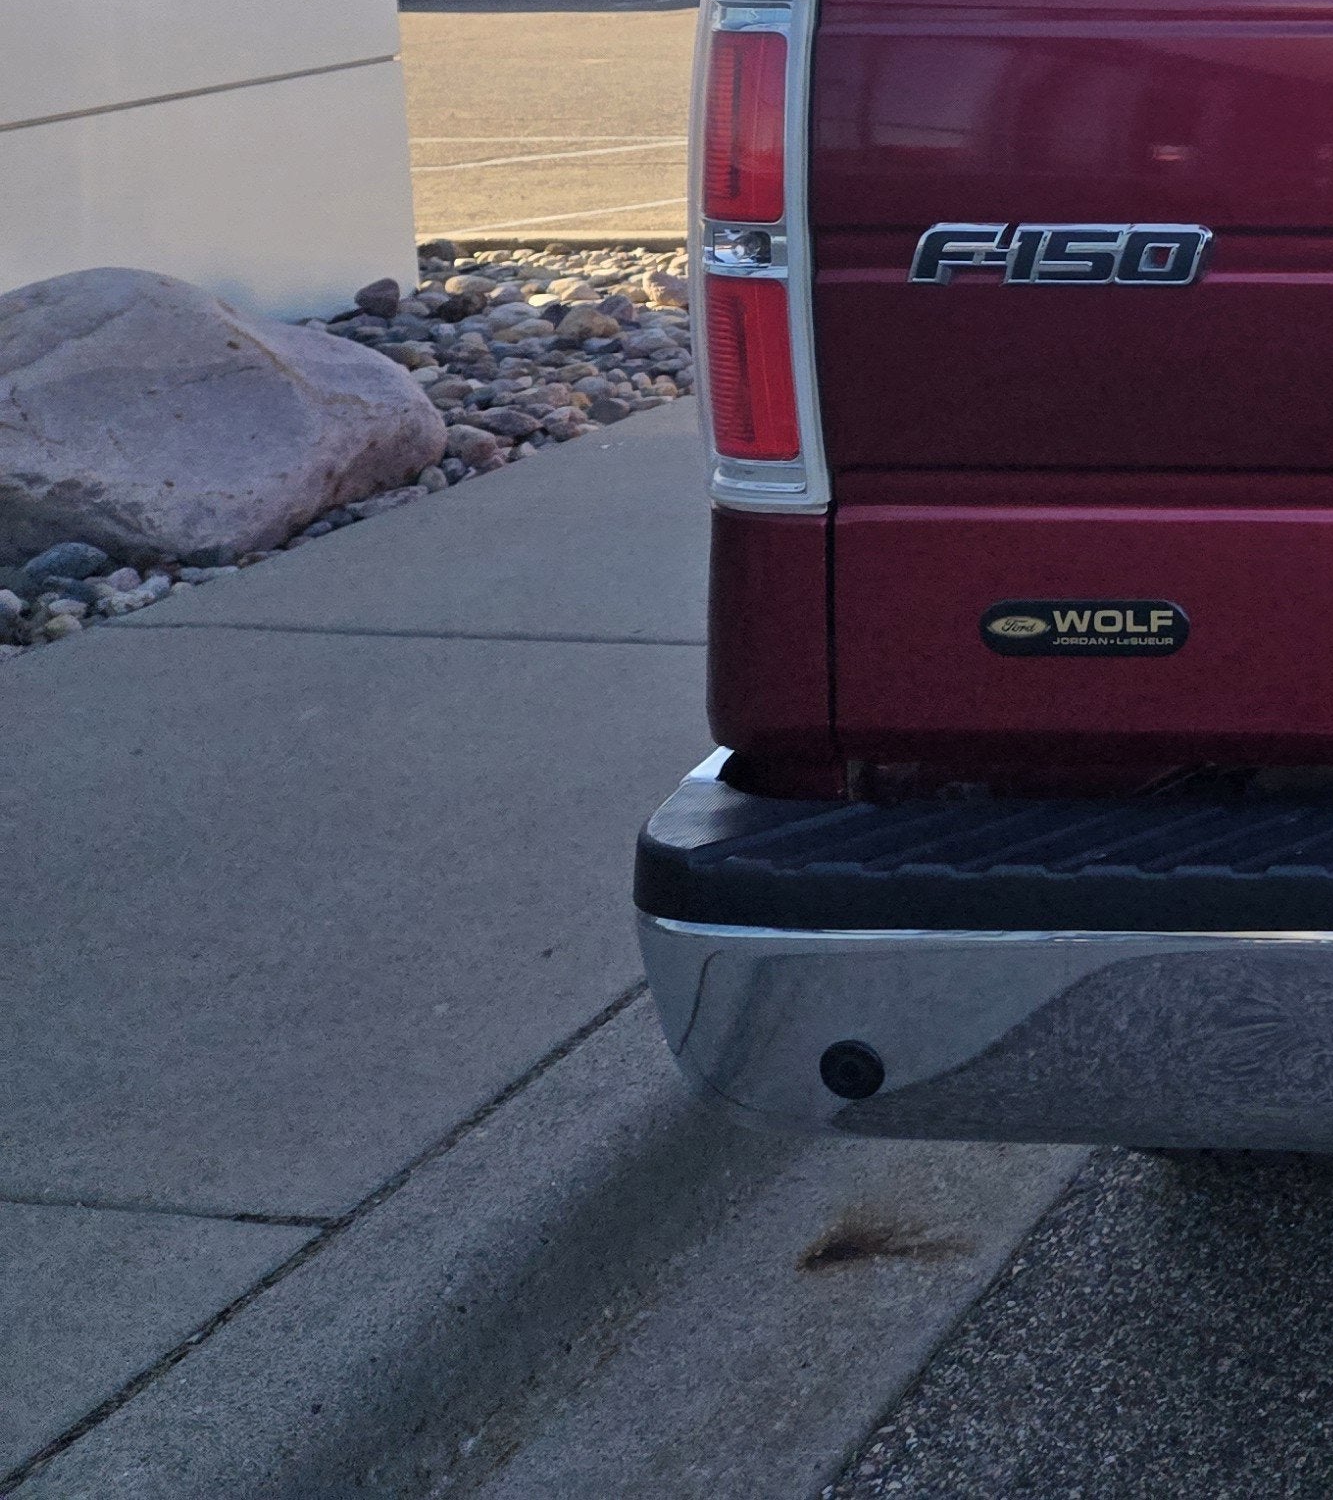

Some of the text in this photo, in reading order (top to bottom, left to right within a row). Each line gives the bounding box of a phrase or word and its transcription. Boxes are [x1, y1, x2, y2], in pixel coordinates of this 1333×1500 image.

[908, 222, 1213, 285] F-150
[1001, 610, 1174, 633] Ford WOLF
[1052, 636, 1108, 646] JORDAN
